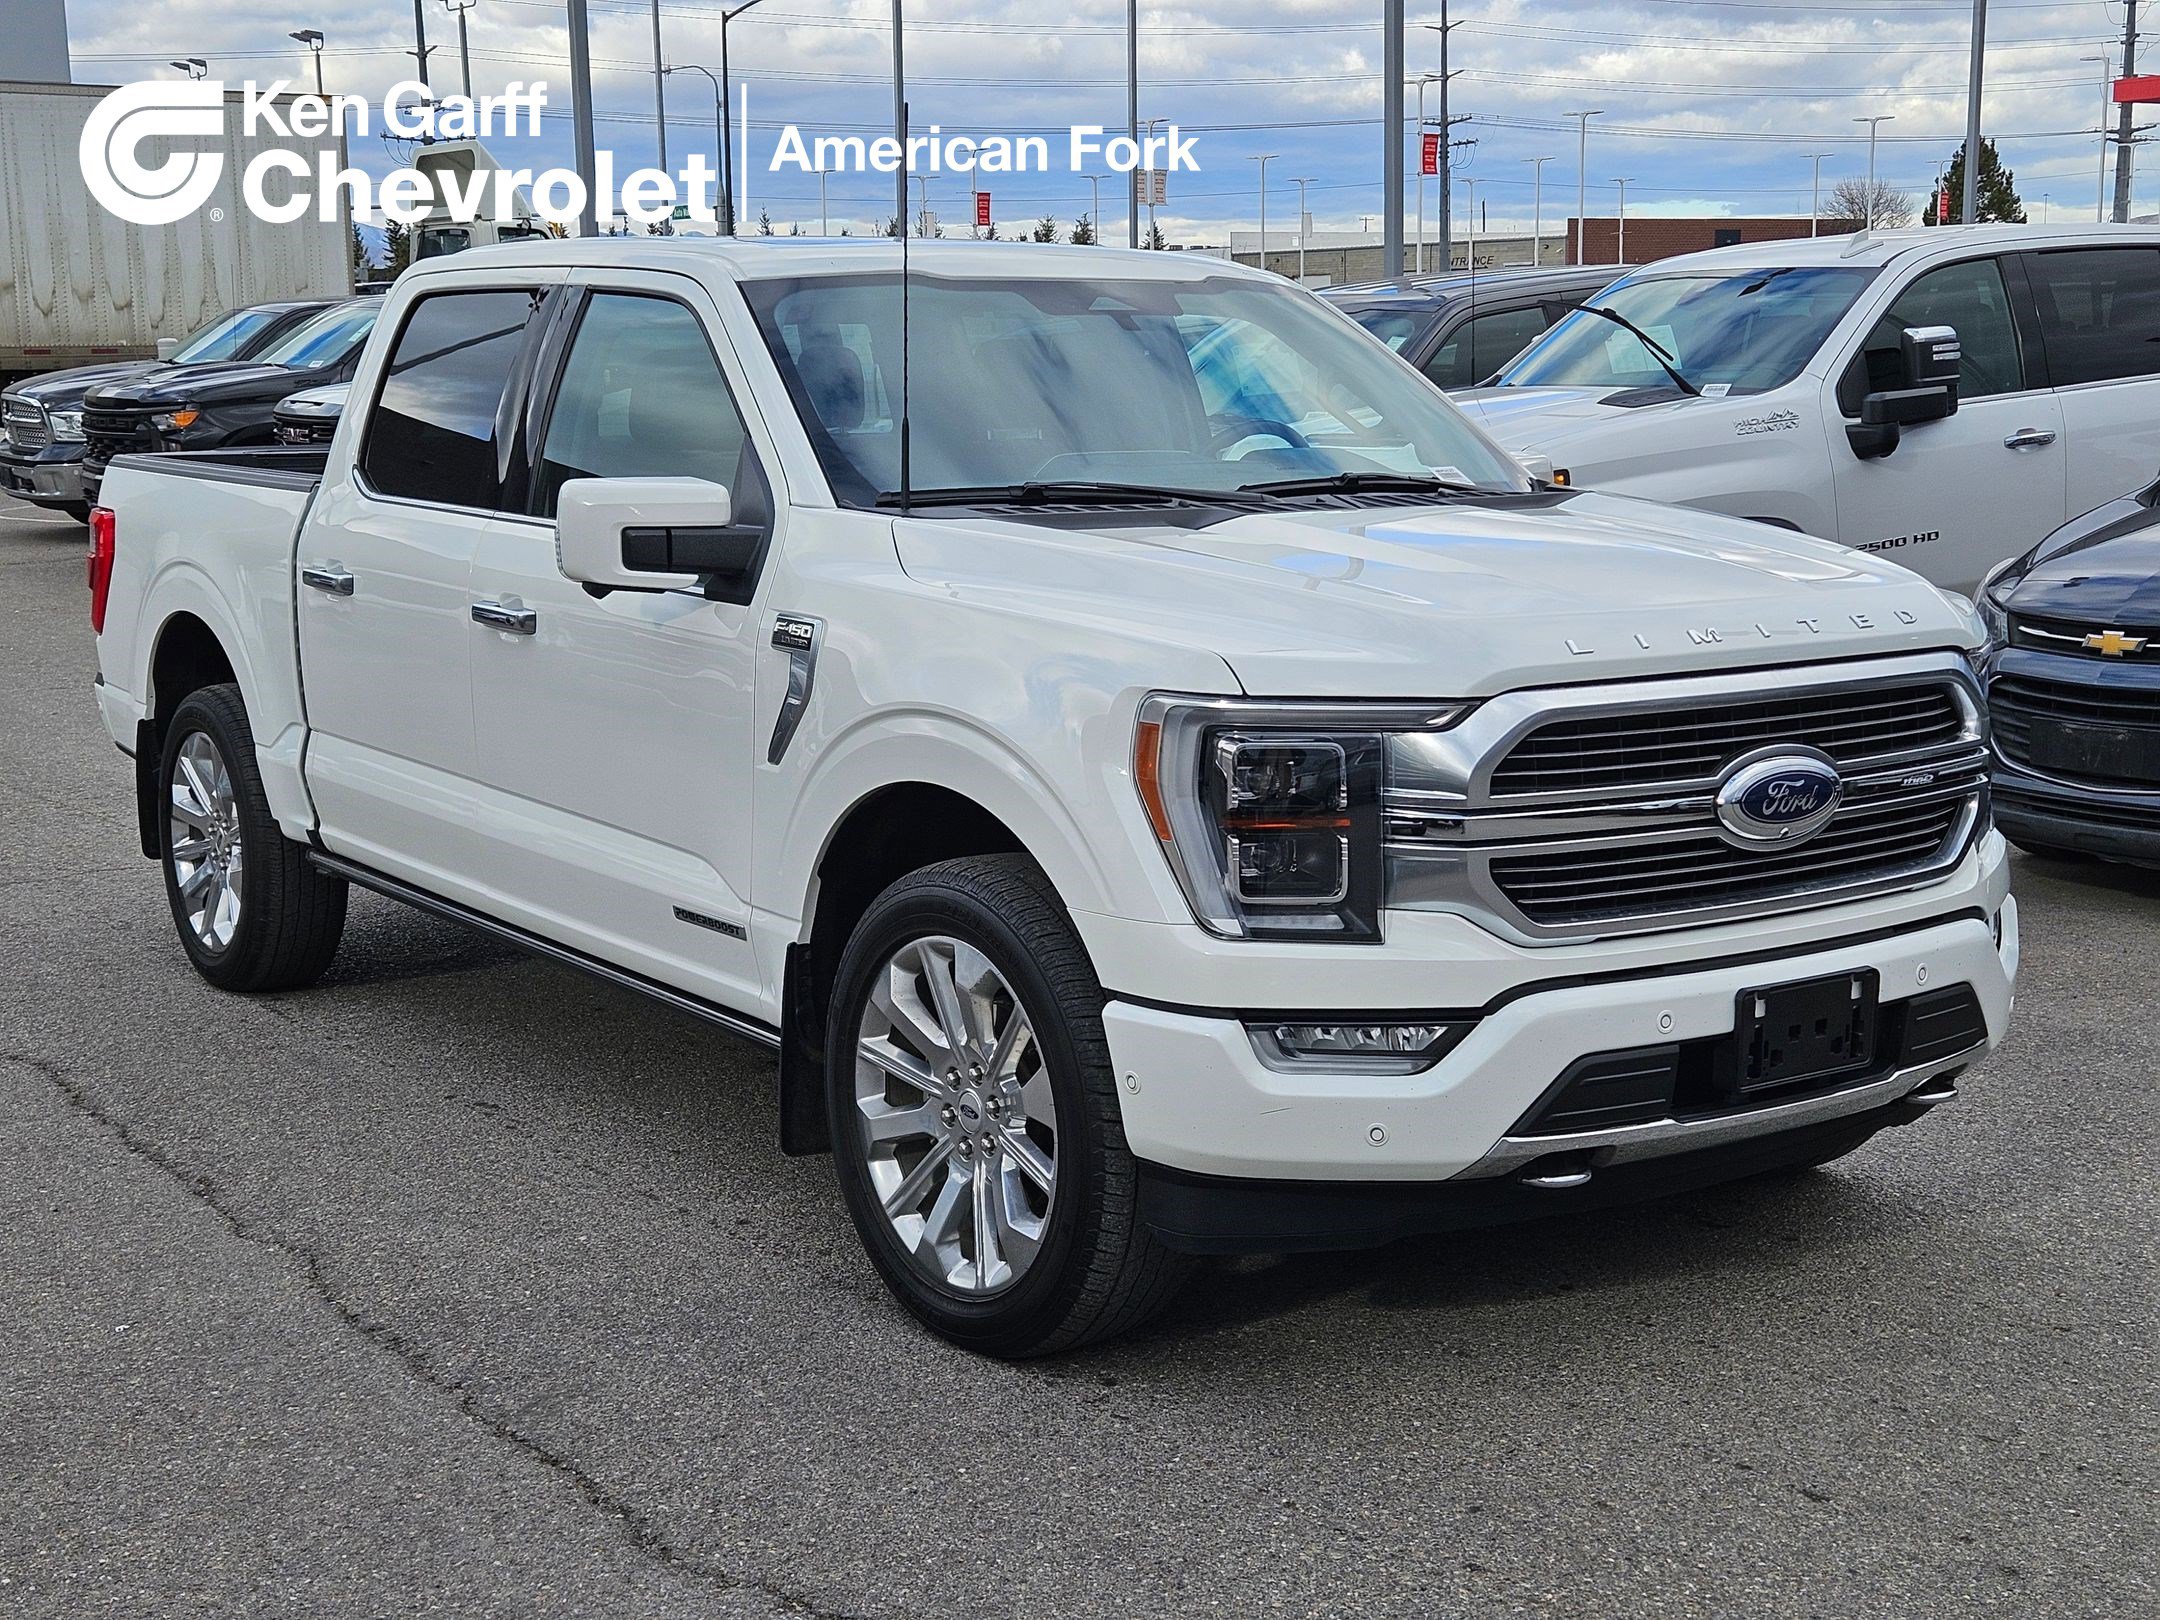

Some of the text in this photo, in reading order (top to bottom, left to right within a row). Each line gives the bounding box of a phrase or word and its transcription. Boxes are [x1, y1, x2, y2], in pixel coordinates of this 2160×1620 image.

[1855, 529, 1940, 553] 2500 HD
[1564, 608, 1919, 656] LIMITED
[1761, 778, 1819, 816] Ford
